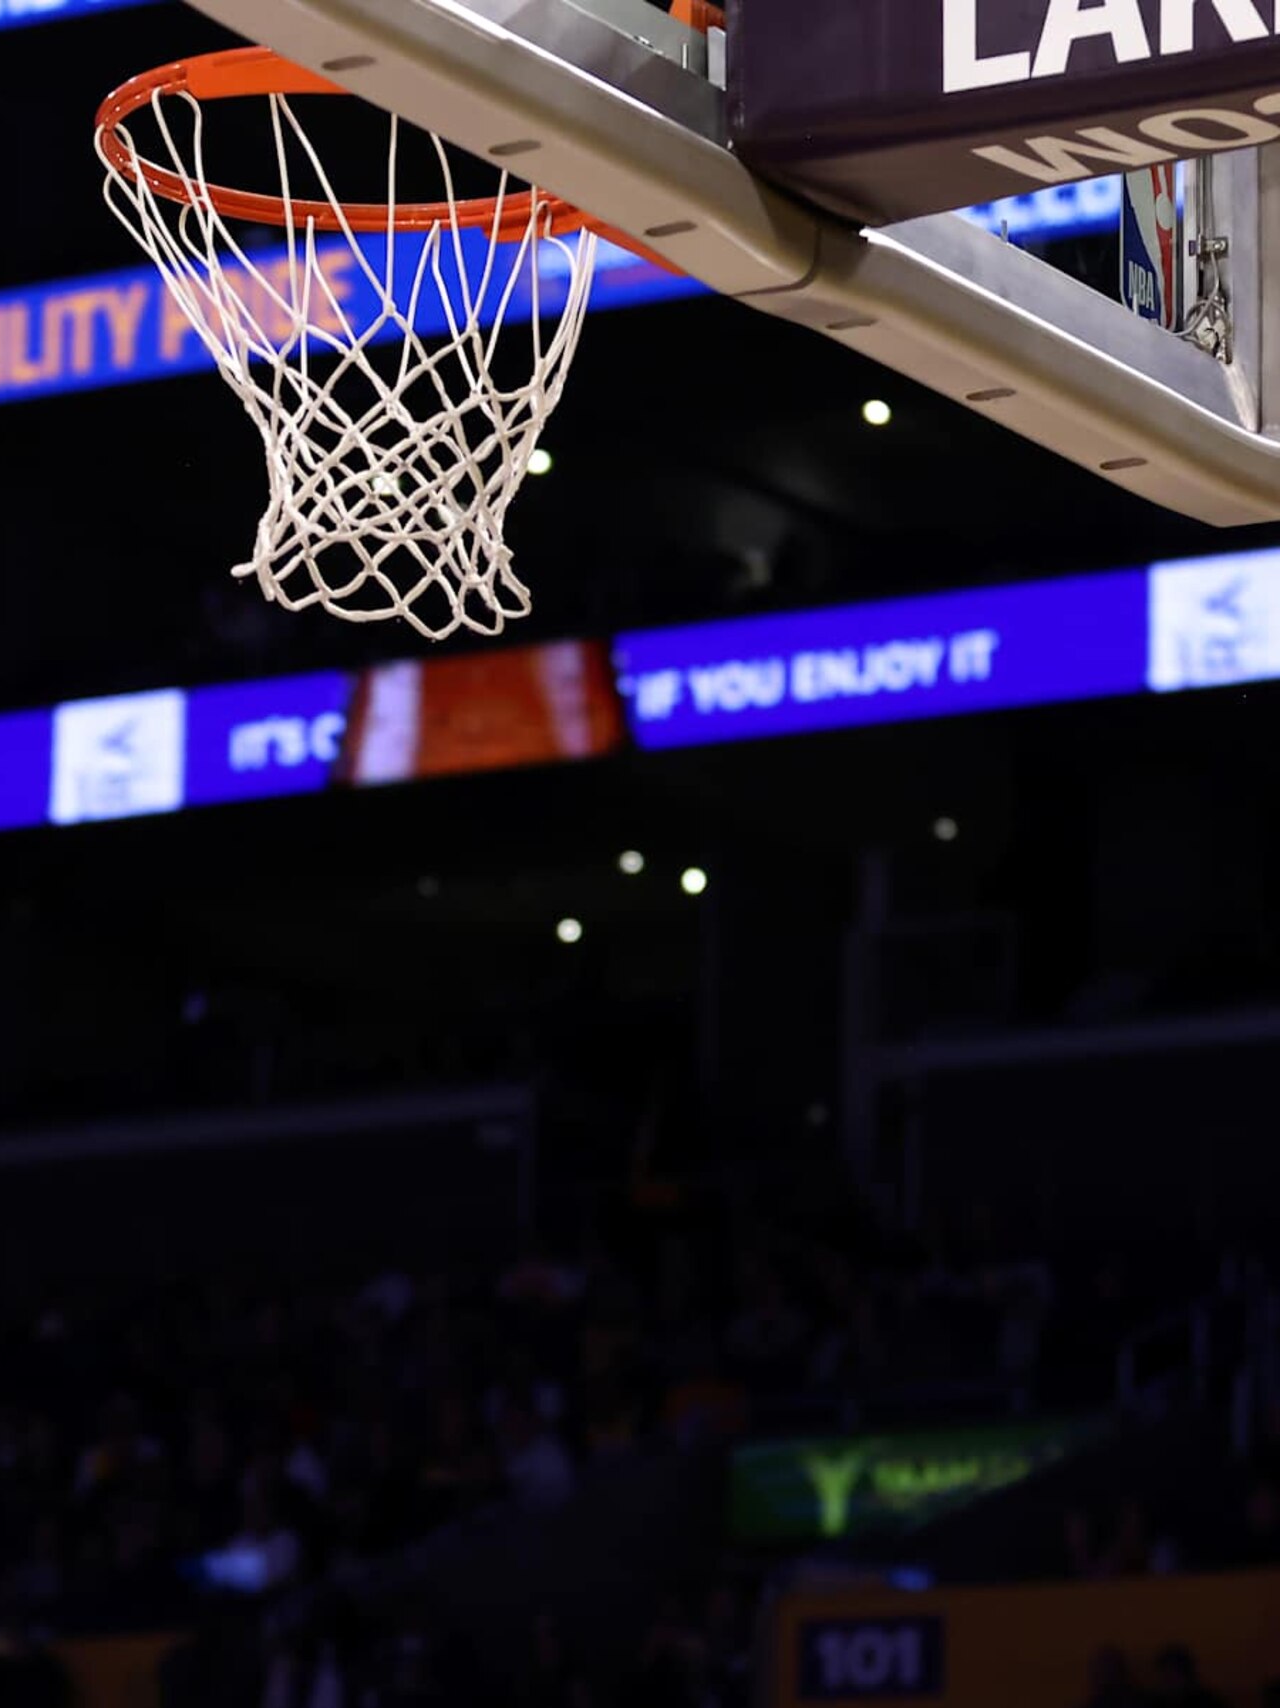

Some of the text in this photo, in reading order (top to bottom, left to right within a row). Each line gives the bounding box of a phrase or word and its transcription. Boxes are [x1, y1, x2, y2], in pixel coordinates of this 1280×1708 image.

[942, 0, 1280, 93] LA
[1128, 260, 1158, 312] NBA
[688, 655, 787, 714] YOU
[790, 637, 946, 703] ENJOY
[947, 627, 1001, 684] IT
[813, 1627, 921, 1688] 101
